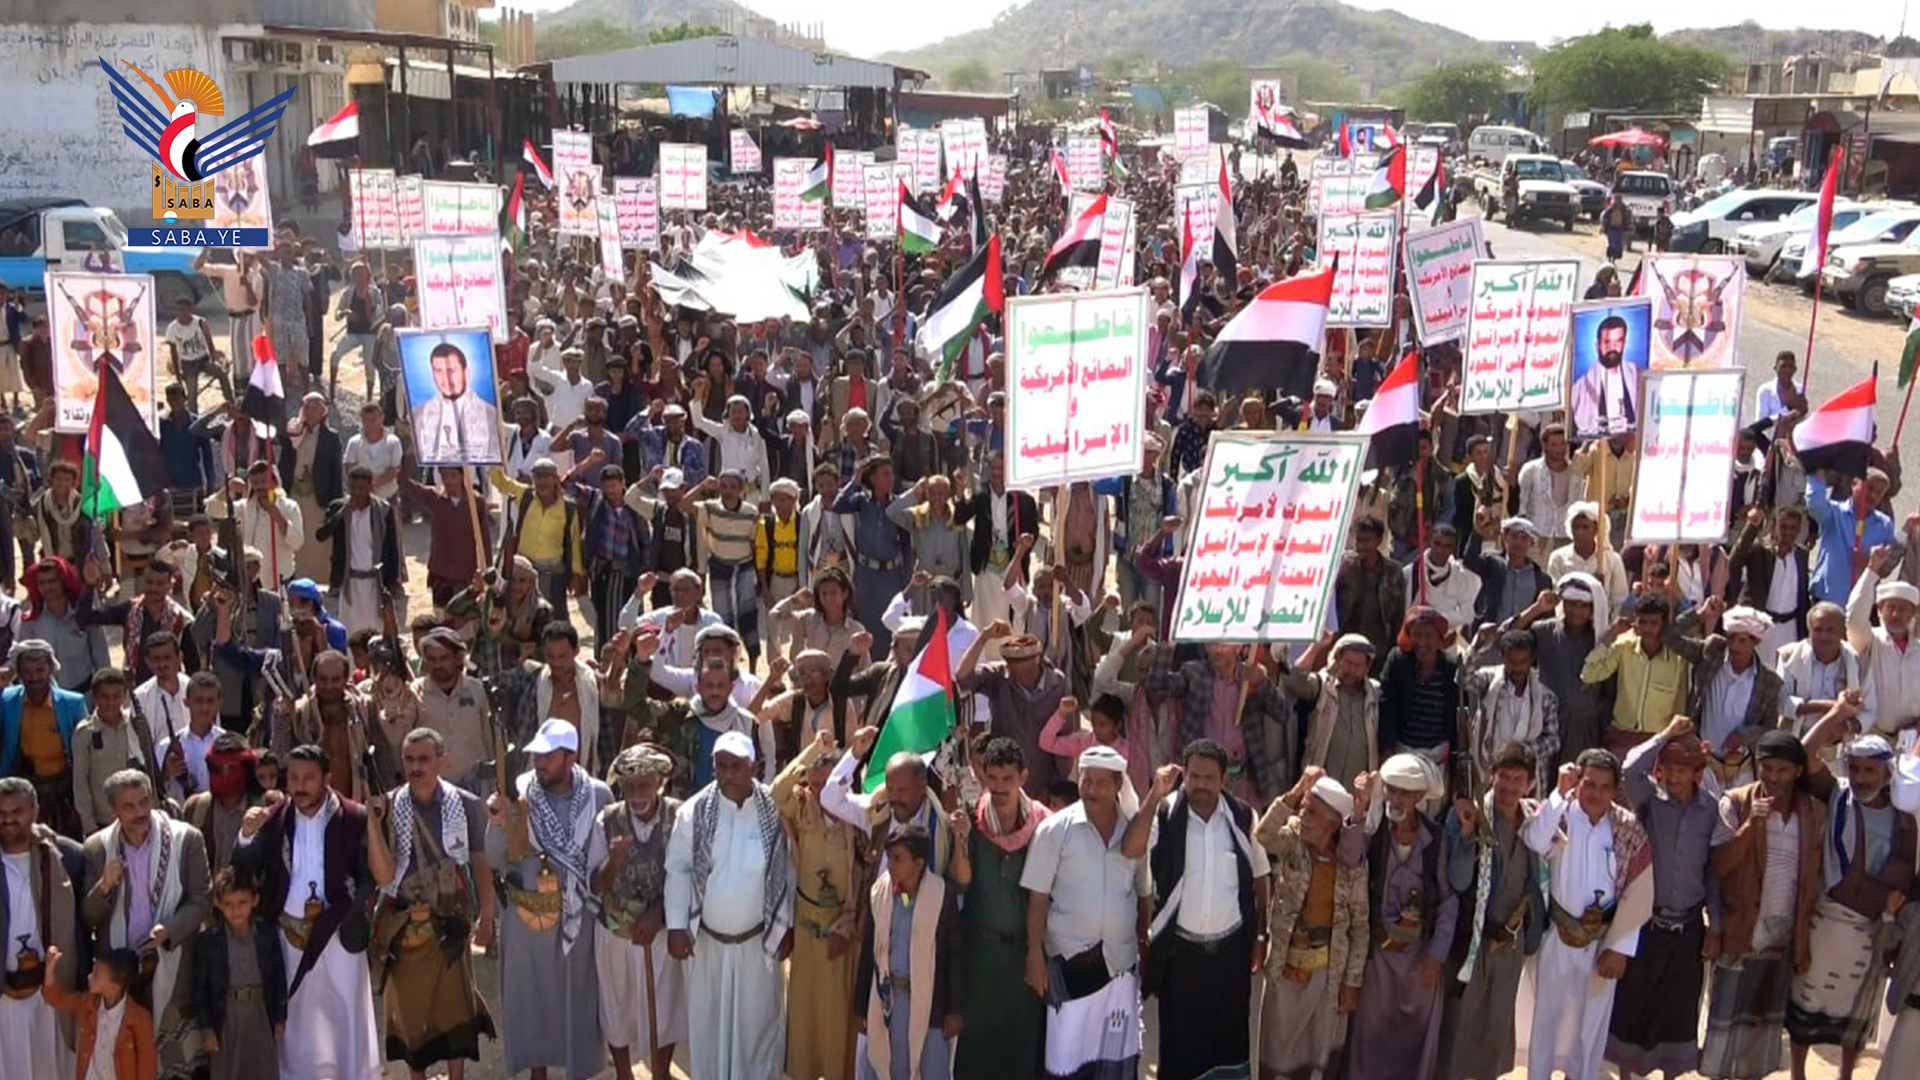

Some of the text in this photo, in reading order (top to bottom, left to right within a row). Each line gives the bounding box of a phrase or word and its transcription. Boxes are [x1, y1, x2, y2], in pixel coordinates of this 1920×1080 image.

[1534, 267, 1572, 291] الله
[1527, 302, 1569, 321] الموت
[1020, 309, 1134, 355] قاطعوا
[1525, 327, 1565, 347] الموت
[1081, 355, 1133, 389] البضائع
[1070, 397, 1078, 418] و
[1210, 445, 1350, 492] الله أكبر
[1282, 500, 1341, 524] الموت
[1273, 532, 1333, 556] الموت
[1189, 564, 1324, 592] اللعنة على اليهود
[1181, 594, 1317, 634] النصر للإسلام
